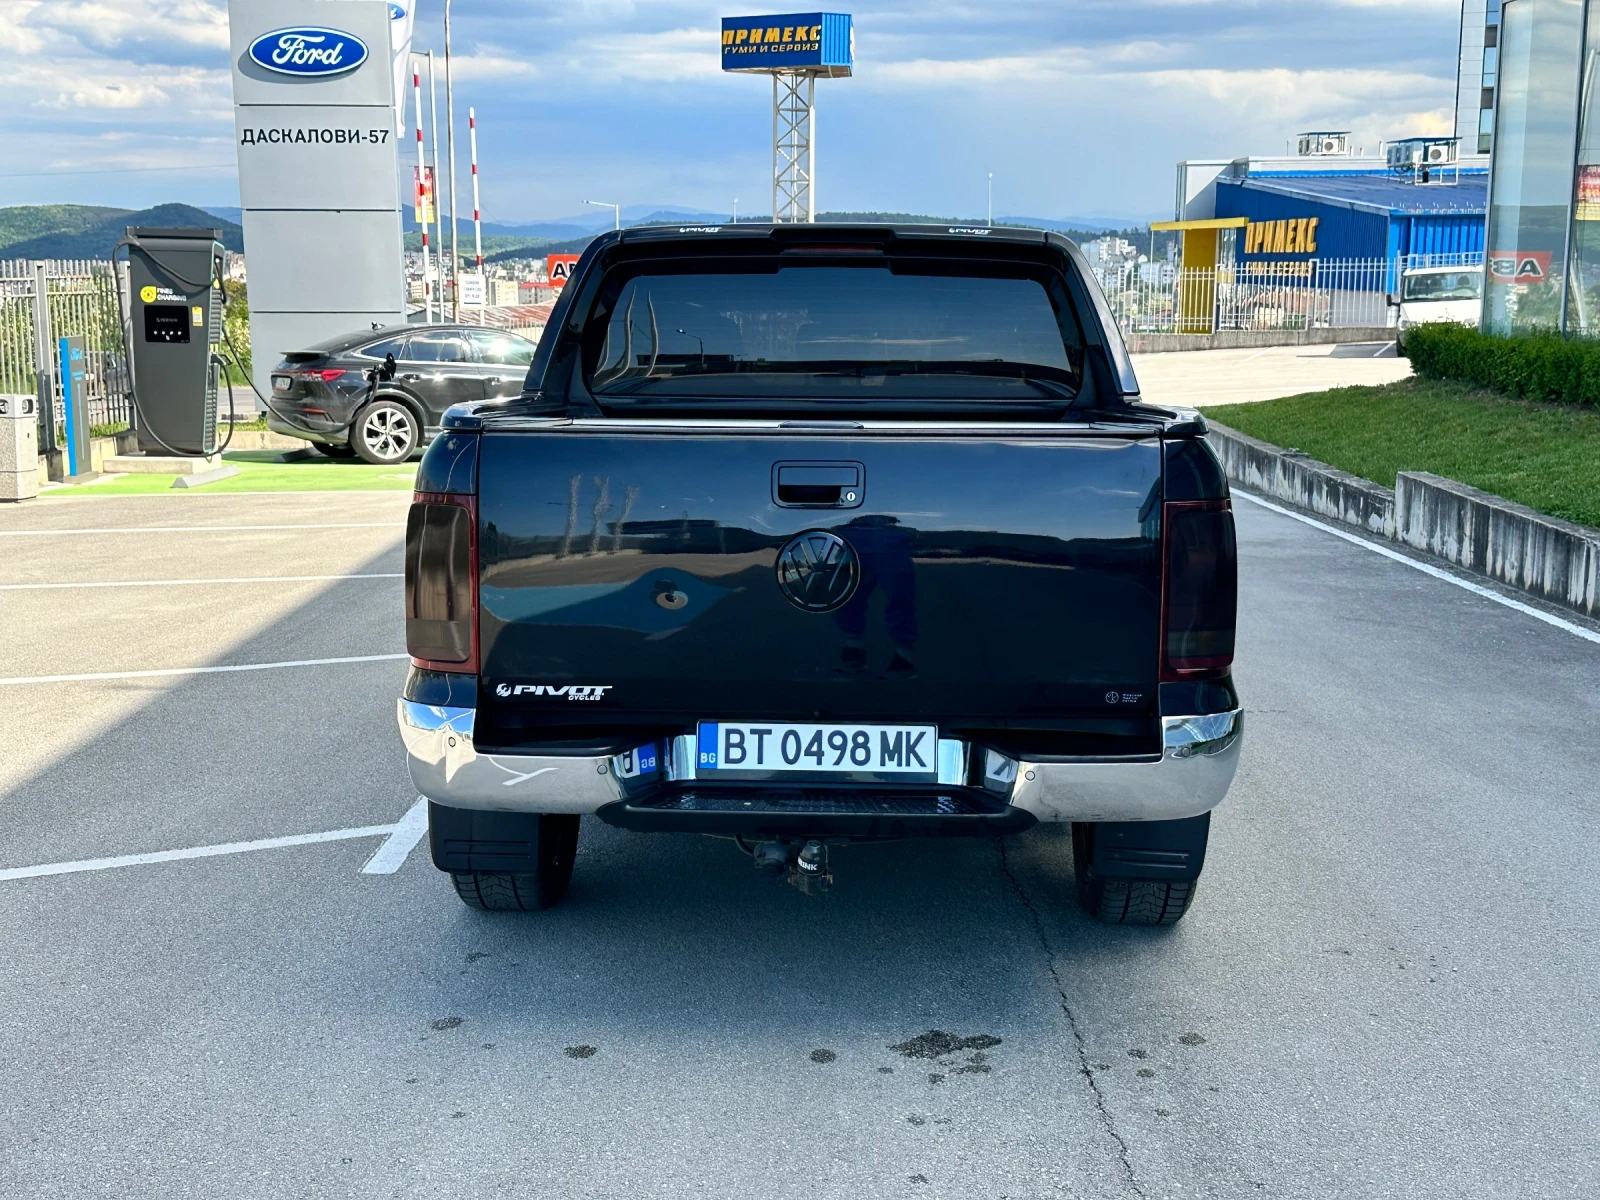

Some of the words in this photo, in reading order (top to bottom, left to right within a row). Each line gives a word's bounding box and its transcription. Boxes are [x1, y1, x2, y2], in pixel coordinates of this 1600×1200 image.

[722, 25, 821, 45] ПРИМЕКС
[271, 34, 343, 65] Ford
[724, 46, 757, 54] ГУМИ
[760, 45, 768, 53] И
[771, 43, 819, 53] СЕРВИЗ
[240, 128, 390, 146] ДАСКАЛОВИ-57
[1244, 217, 1319, 254] ПРИМЕКС
[513, 685, 612, 696] PIVOT
[724, 728, 773, 765] BT
[780, 729, 871, 767] 0498
[879, 730, 928, 768] MK
[700, 752, 717, 764] BG
